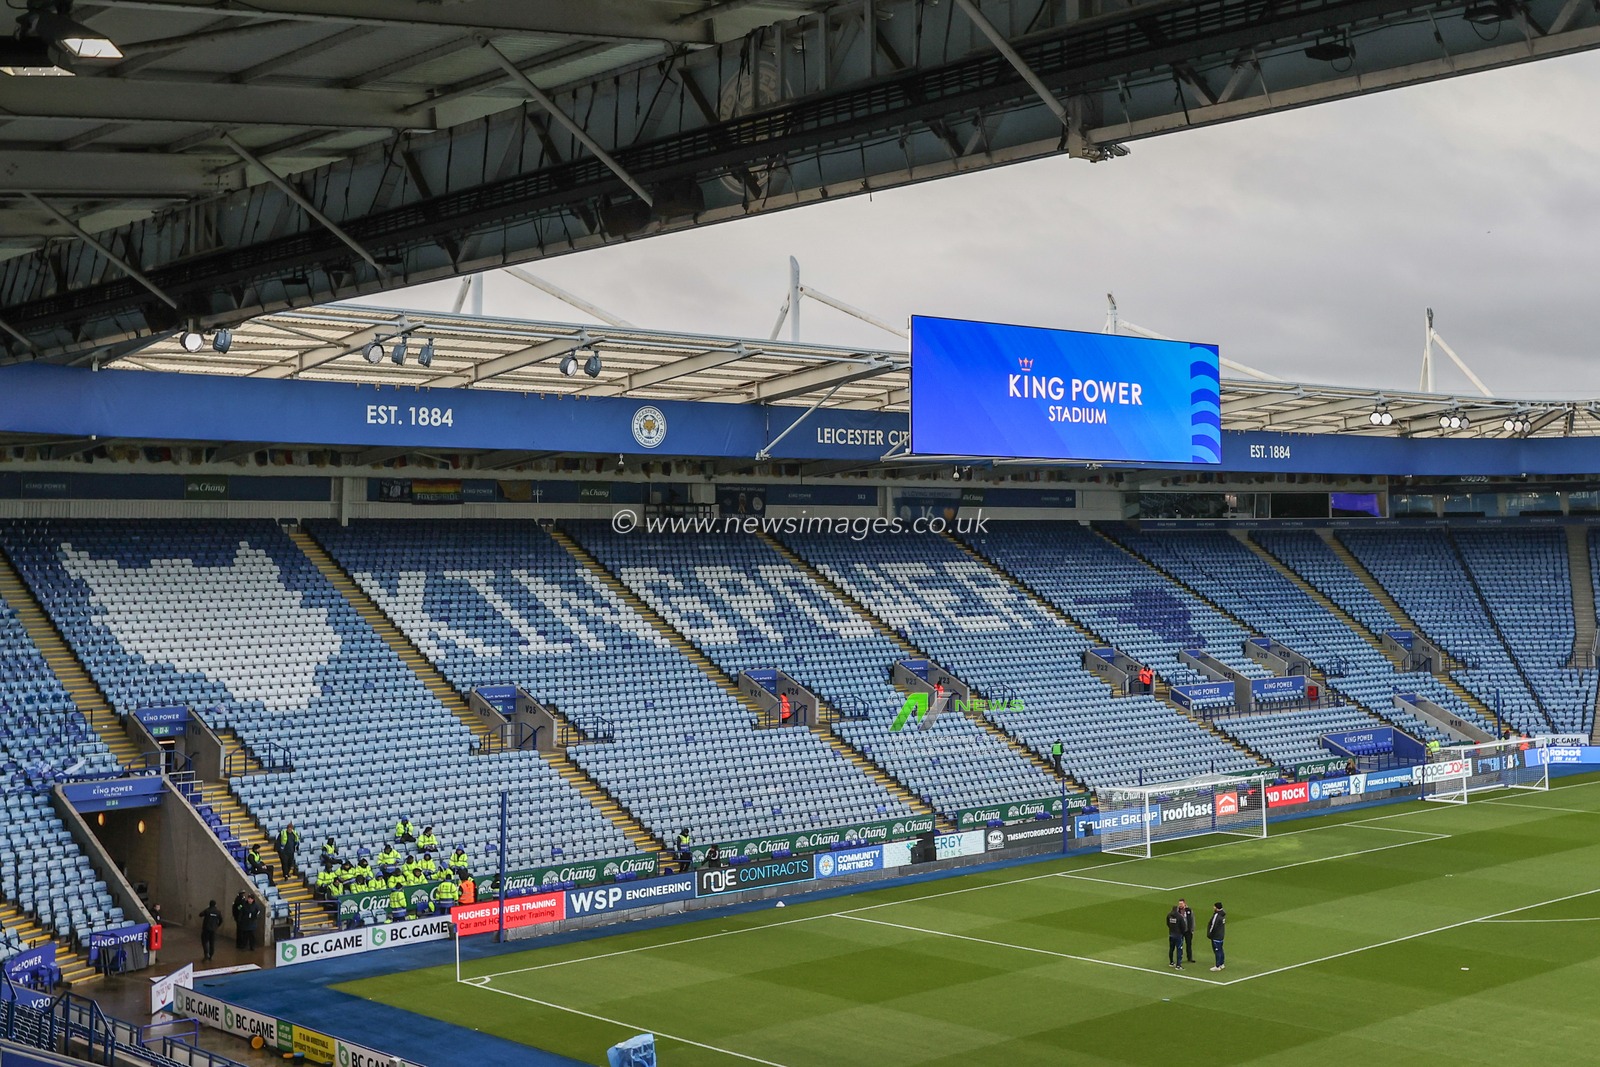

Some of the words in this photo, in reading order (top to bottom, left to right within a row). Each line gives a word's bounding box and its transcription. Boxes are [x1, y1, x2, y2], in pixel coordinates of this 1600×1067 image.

[1008, 373, 1064, 401] KING
[1071, 378, 1143, 406] POWER
[366, 405, 403, 426] EST.
[409, 406, 454, 428] 1884
[1048, 405, 1107, 425] STADIUM
[817, 427, 884, 446] LEICESTER
[888, 430, 909, 447] CIT
[1249, 444, 1267, 459] EST.
[1269, 445, 1290, 459] 1884
[199, 483, 226, 494] Chang
[787, 687, 799, 696] V24
[1188, 689, 1201, 697] KING
[1202, 687, 1220, 695] POWER
[1263, 682, 1276, 690] KING
[1277, 681, 1293, 689] POWER
[750, 689, 762, 698] V24
[479, 707, 491, 717] V25
[525, 705, 537, 714] V25
[143, 713, 158, 722] KING
[159, 713, 180, 721] POWER
[1344, 736, 1356, 744] KING
[1356, 734, 1373, 742] POWER
[1549, 748, 1582, 757] Robot
[1306, 763, 1326, 775] Chang
[1335, 759, 1348, 770] Cha
[93, 786, 110, 795] KING
[110, 785, 133, 793] POWER
[1281, 787, 1306, 801] ROCK
[974, 810, 1001, 822] Chang
[1019, 802, 1044, 816] Chang
[1162, 802, 1212, 822] roofbase
[1219, 804, 1236, 814] .com
[905, 819, 933, 833] Chang
[809, 832, 839, 847] Chang
[858, 826, 887, 841] Chang
[989, 833, 1002, 841] TMS
[758, 839, 790, 854] Chang
[935, 834, 963, 850] ERGY
[705, 846, 738, 860] Cang
[837, 849, 879, 864] COMMUNITY
[619, 858, 655, 874] Chang
[739, 859, 809, 882] CONTRACTS
[837, 859, 874, 872] PARTNERS
[559, 867, 597, 883] Chang
[504, 876, 535, 890] hang
[359, 893, 391, 912] Chan
[570, 887, 622, 913] WSP
[625, 881, 692, 900] ENGINEERING
[458, 908, 491, 921] HUGHES
[521, 899, 557, 913] TRAINING
[459, 921, 471, 930] Car
[472, 918, 487, 928] and
[488, 916, 502, 925] HG
[506, 913, 526, 924] Driver
[527, 909, 556, 922] Training
[390, 921, 449, 942] BC.GAME
[301, 934, 363, 957] BC.GAME
[22, 956, 42, 970] POWER
[31, 998, 51, 1010] V30
[185, 996, 220, 1022] BC.GAME
[235, 1013, 275, 1040] BC.GAME
